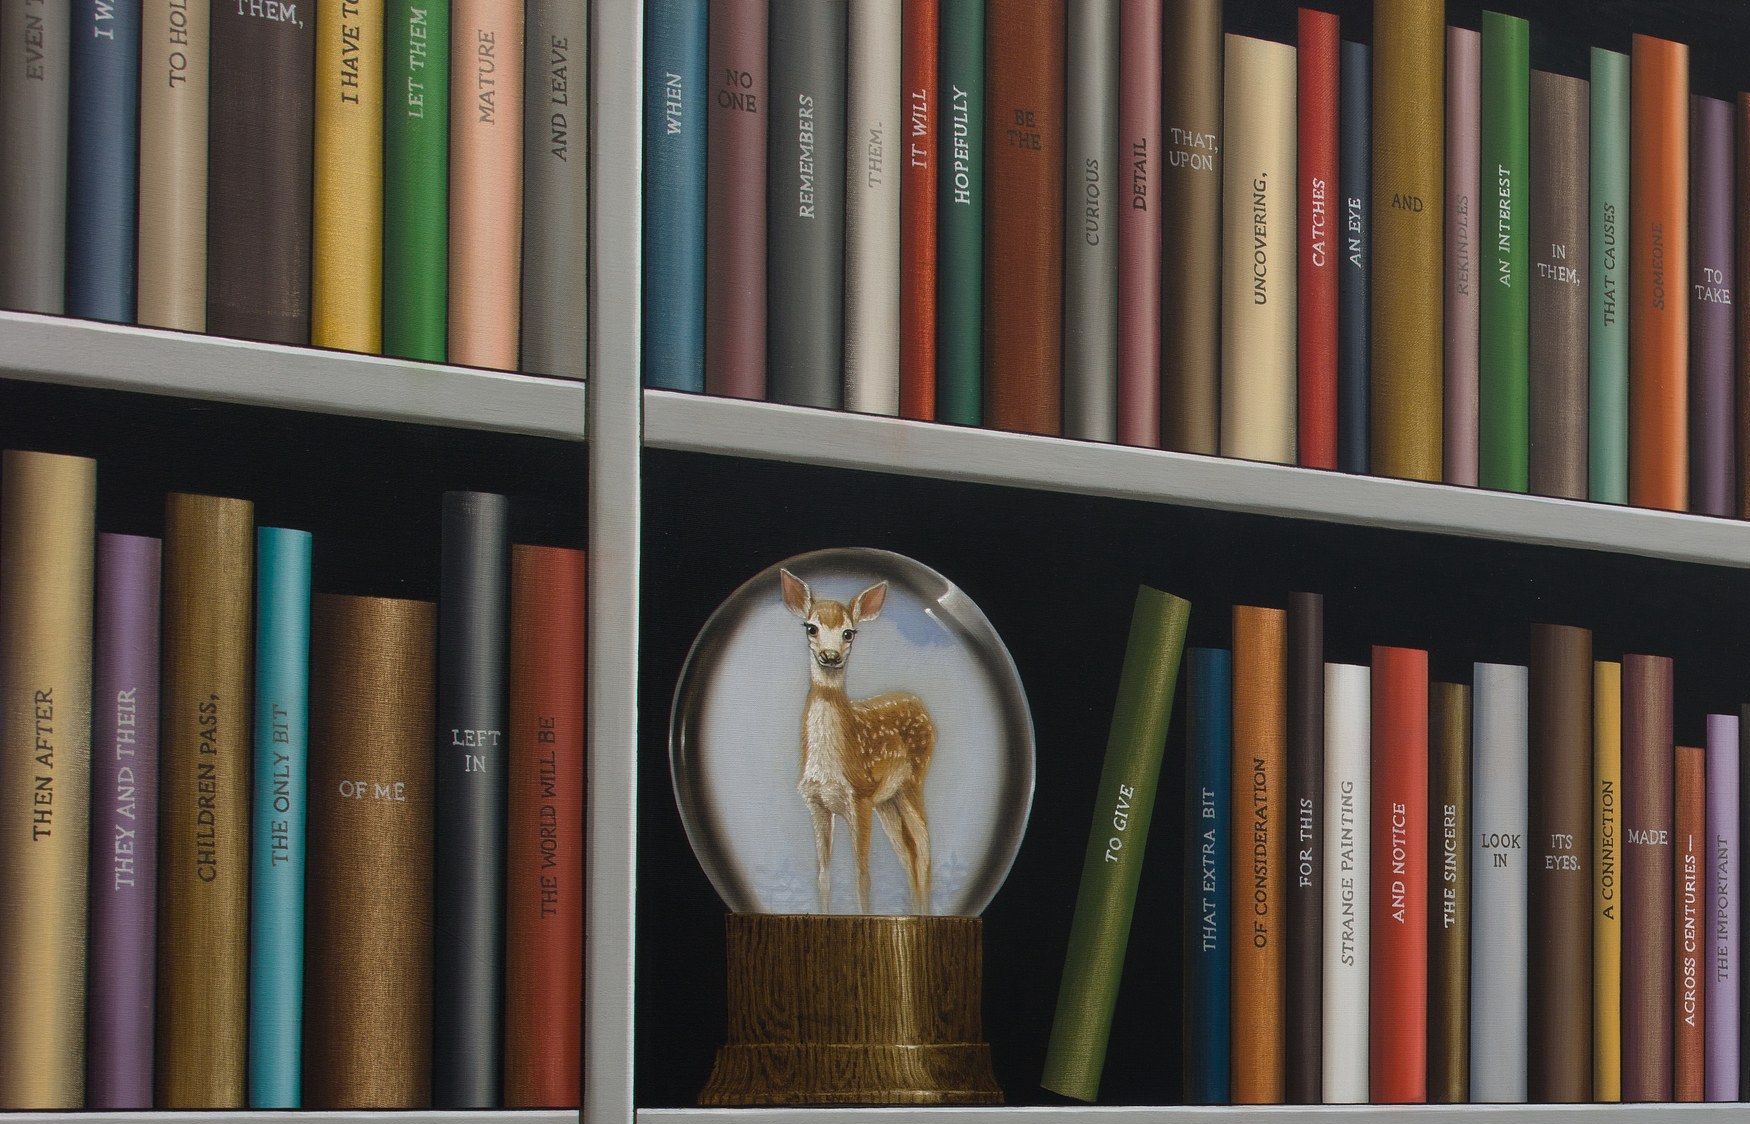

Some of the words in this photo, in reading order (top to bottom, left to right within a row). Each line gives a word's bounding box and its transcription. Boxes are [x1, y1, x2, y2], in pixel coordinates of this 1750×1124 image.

[341, 24, 360, 88] HAVE
[410, 7, 427, 70] THEM
[342, 92, 359, 104] I
[408, 78, 424, 119] LET
[478, 29, 495, 125] MATURE
[551, 36, 568, 107] LEAVE
[725, 69, 753, 89] NO
[666, 72, 682, 135] WHEN
[717, 92, 757, 113] ONE
[912, 89, 927, 137] WILL
[551, 114, 567, 162] AND
[799, 95, 815, 219] REMEMBERS
[868, 121, 883, 188] THEM.
[912, 140, 927, 169] IT
[952, 85, 970, 205] HOPEFULLY
[1169, 151, 1213, 172] UPON
[1171, 127, 1219, 153] THAT,
[1133, 138, 1147, 212] DETAIL
[1311, 177, 1326, 267] CATCHES
[1498, 164, 1511, 252] INTEREST
[1604, 202, 1616, 271] CAUSES
[1253, 172, 1268, 305] UNCOVERING,
[1499, 258, 1511, 288] AN
[1604, 279, 1616, 328] THAT
[34, 687, 54, 769] AFTER
[117, 687, 137, 763] THEIR
[201, 694, 219, 757] PASS,
[273, 704, 288, 745] BIT
[33, 776, 53, 842] THEN
[116, 767, 136, 820] AND
[273, 753, 289, 813] ONLY
[1113, 784, 1135, 831] GIVE
[1202, 788, 1216, 819] BIT
[197, 764, 218, 883] CHILDREN
[272, 820, 289, 866] THE
[1105, 838, 1123, 863] TO
[1253, 758, 1267, 916] CONSIDERATION
[1392, 803, 1405, 876] NOTICE
[1481, 833, 1521, 849] LOOK
[1602, 780, 1614, 902] CONNECTION
[1628, 828, 1668, 845] MADE
[115, 828, 136, 891] THEY
[1203, 829, 1216, 893] EXTRA
[1493, 853, 1508, 868] IN
[1203, 899, 1216, 952] THAT
[1392, 881, 1405, 923] AND
[1602, 905, 1614, 920] A
[1254, 922, 1267, 948] OF
[1685, 958, 1696, 1027] ACROSS
